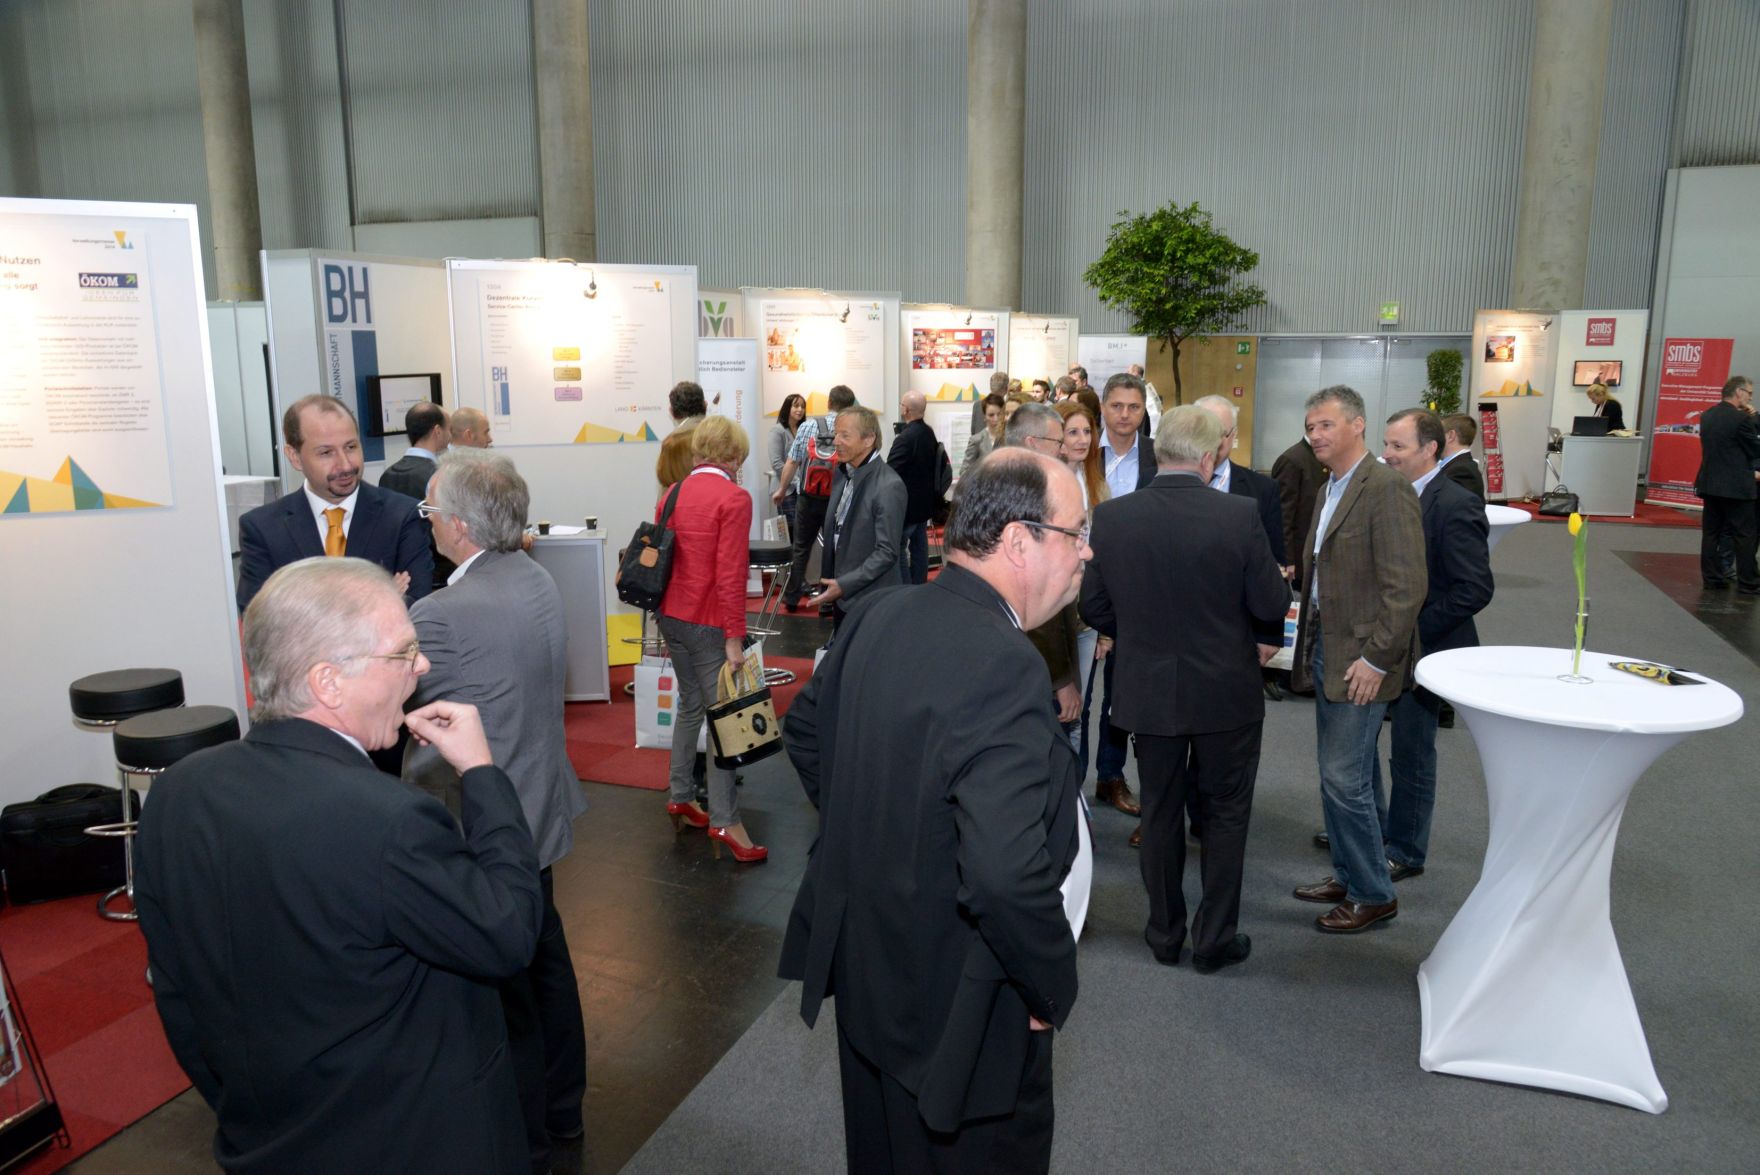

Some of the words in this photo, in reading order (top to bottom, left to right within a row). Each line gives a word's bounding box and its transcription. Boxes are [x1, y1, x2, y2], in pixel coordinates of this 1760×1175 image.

[0, 255, 41, 265] Nutzen
[80, 273, 119, 287] ÖKOM
[324, 264, 372, 324] BH
[1590, 321, 1613, 335] smbs
[1668, 343, 1701, 362] smbs
[491, 366, 507, 381] BH
